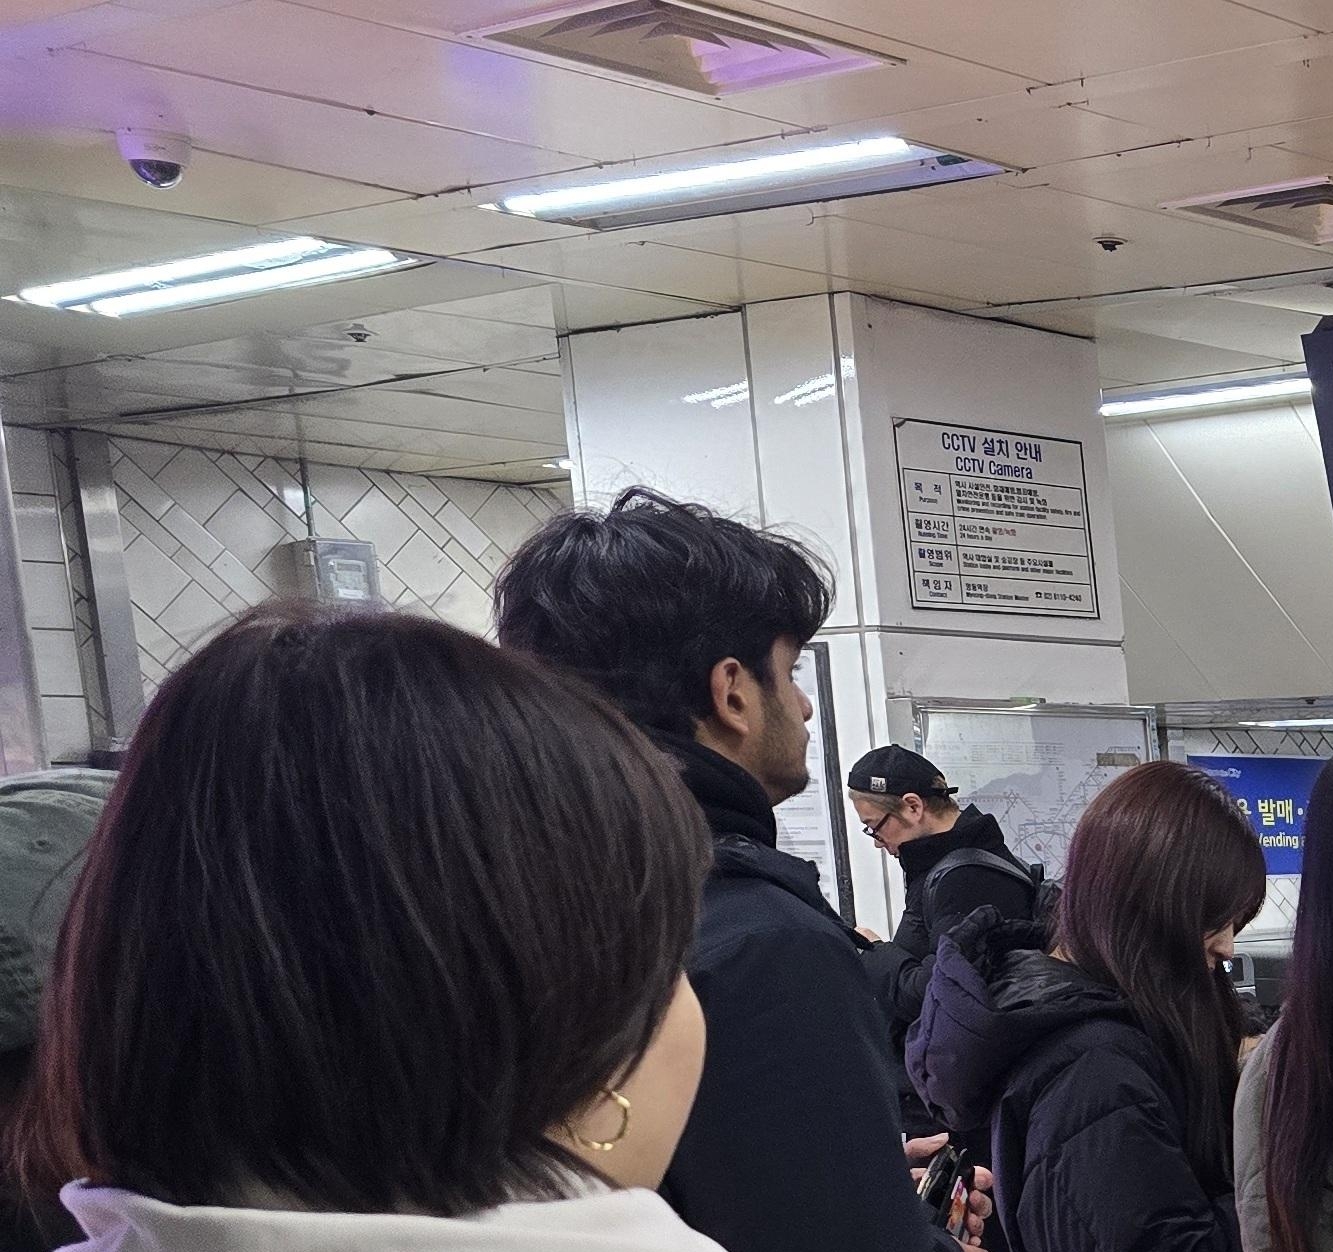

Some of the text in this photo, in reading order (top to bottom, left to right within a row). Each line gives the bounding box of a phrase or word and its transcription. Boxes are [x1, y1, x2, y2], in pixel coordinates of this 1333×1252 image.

[941, 432, 1042, 462] CCTV 설치 안내
[955, 456, 1033, 480] CCTV Camera
